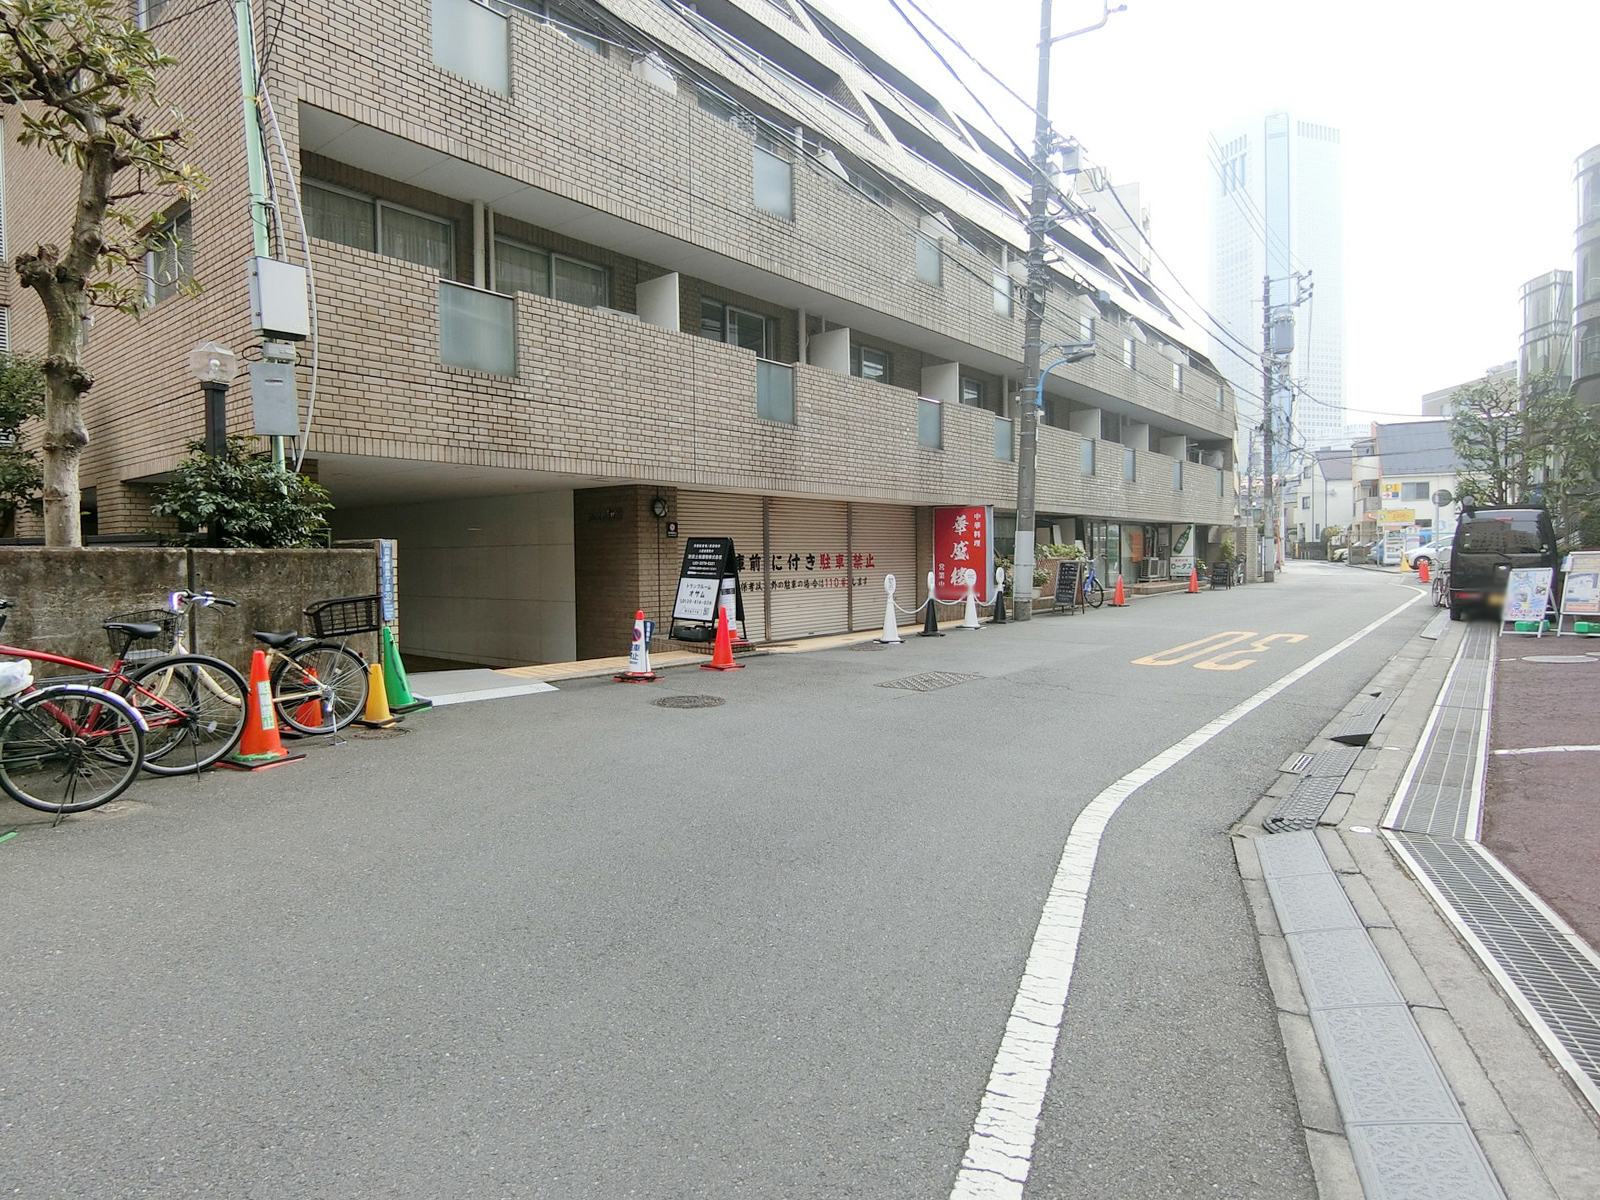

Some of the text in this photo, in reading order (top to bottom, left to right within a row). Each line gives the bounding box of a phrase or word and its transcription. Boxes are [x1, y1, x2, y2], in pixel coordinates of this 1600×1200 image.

[689, 590, 705, 598] オサム
[1130, 631, 1309, 671] 30
